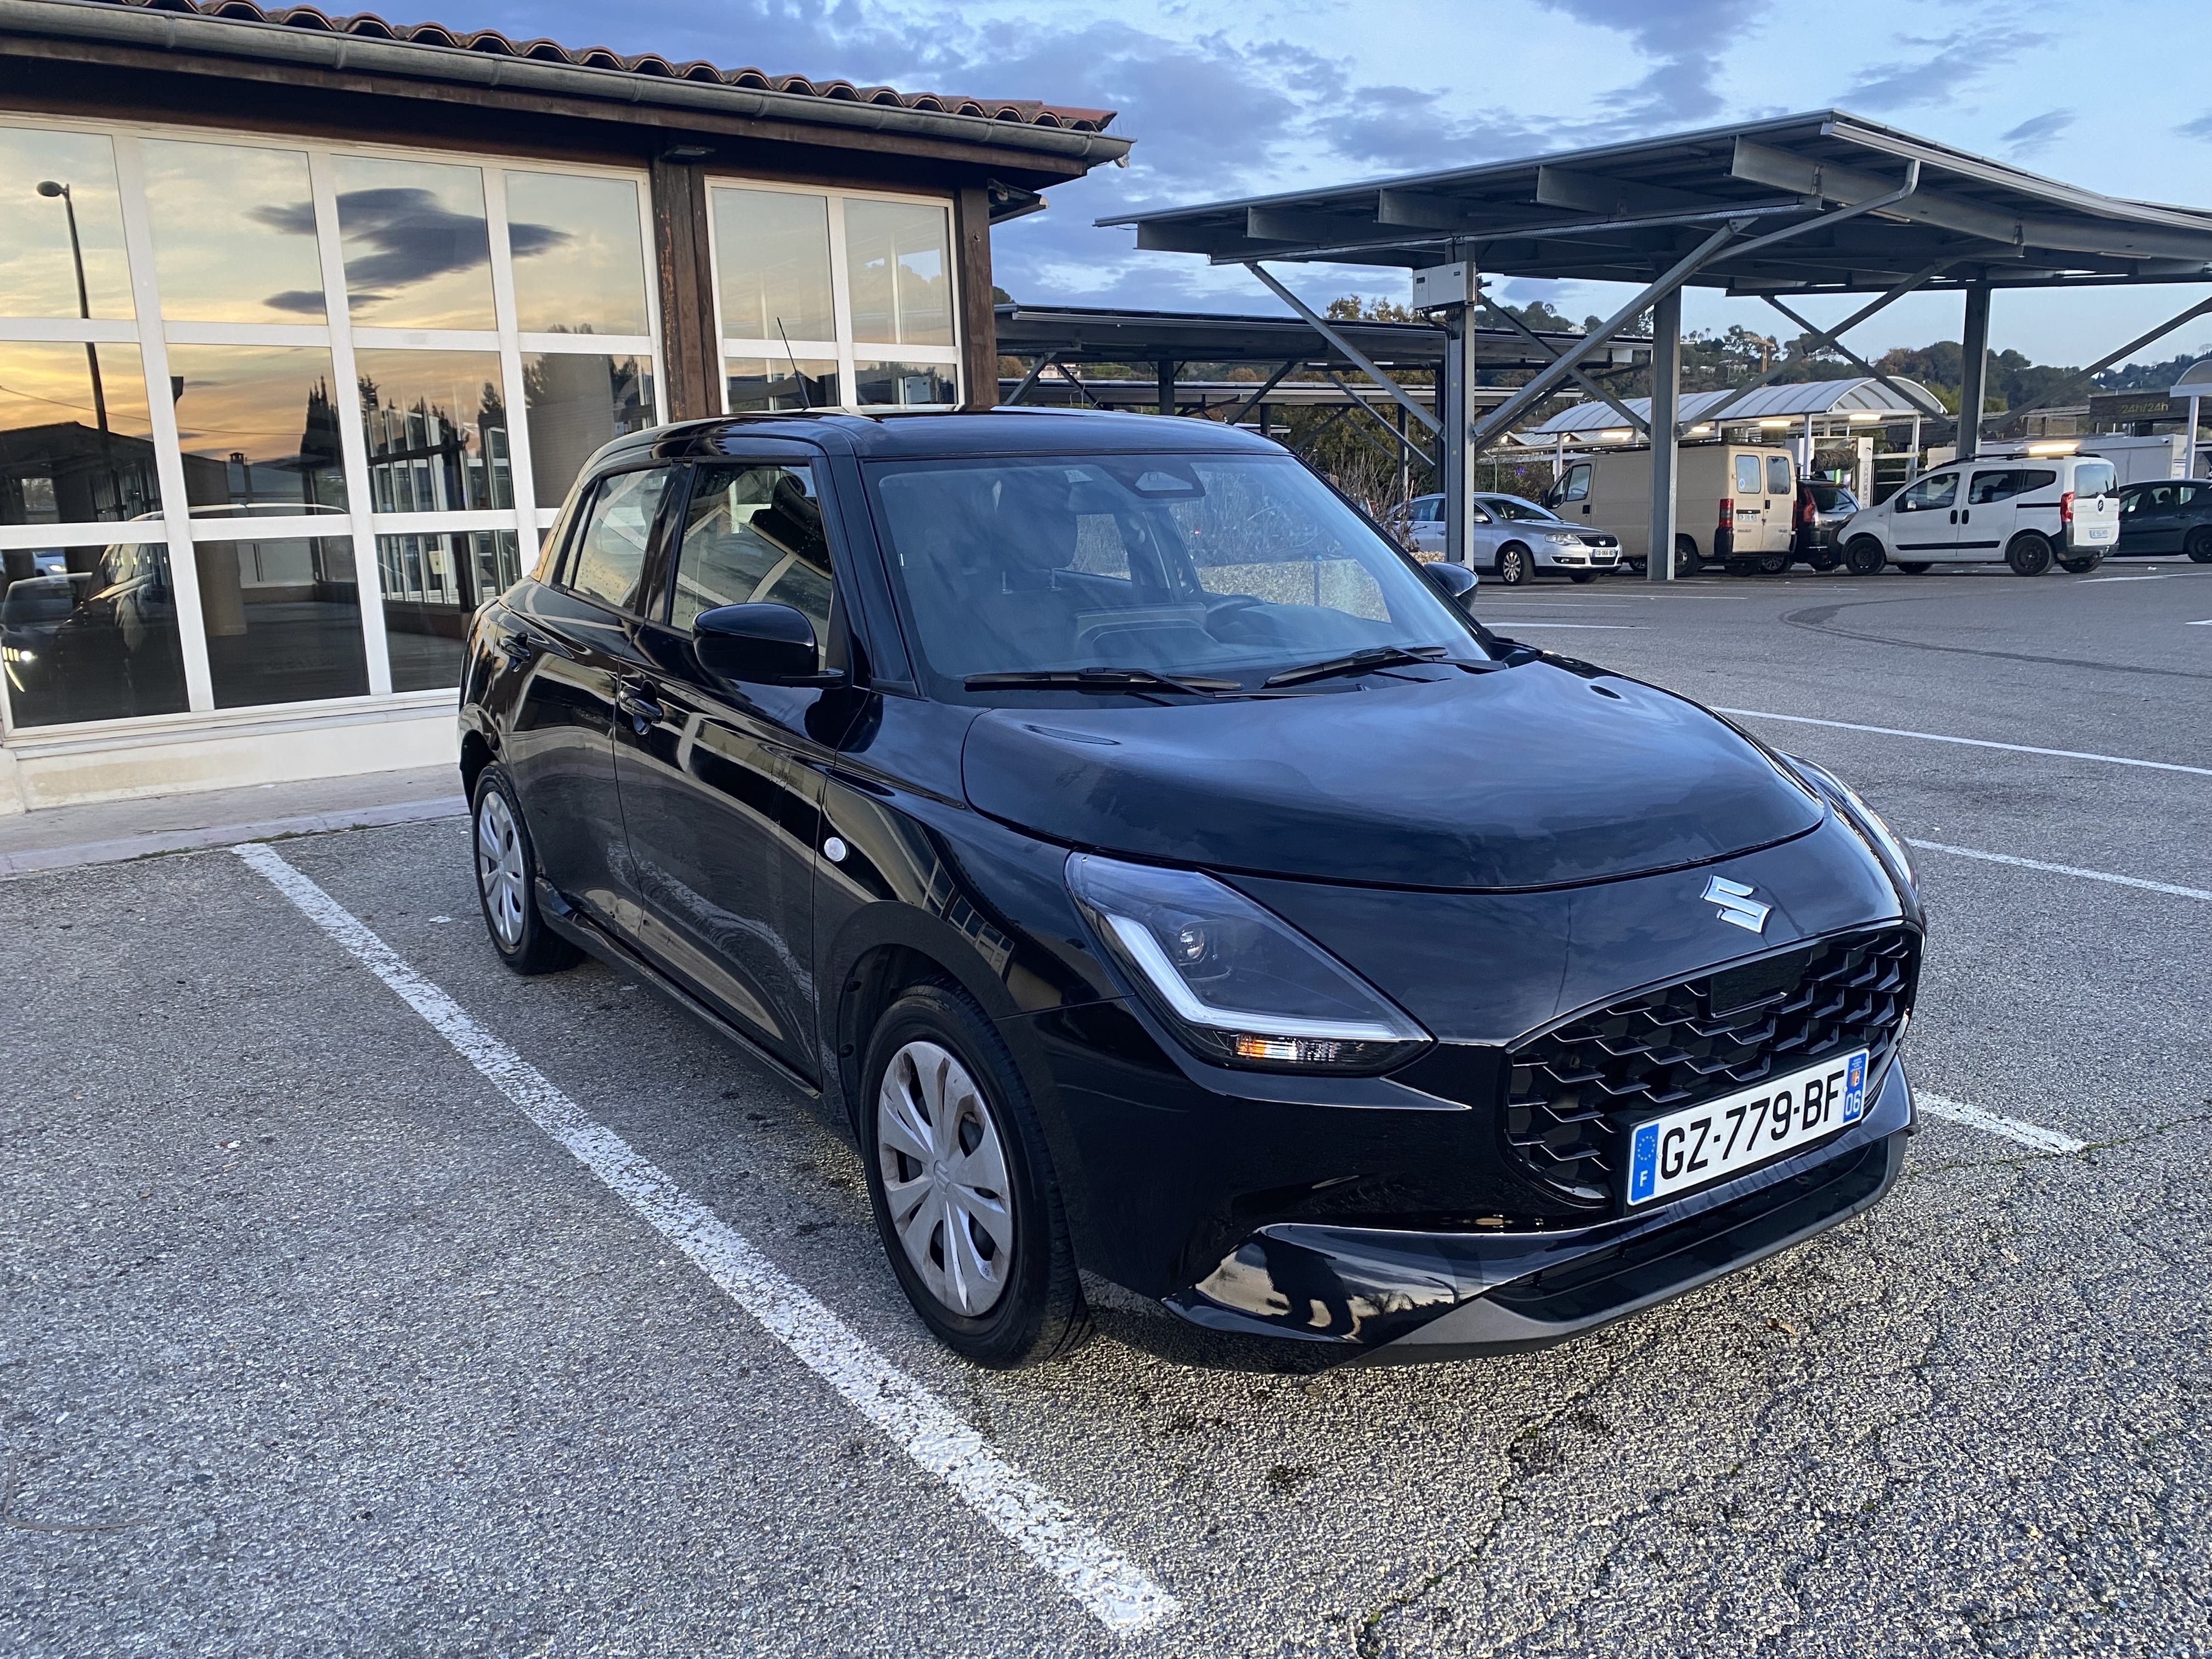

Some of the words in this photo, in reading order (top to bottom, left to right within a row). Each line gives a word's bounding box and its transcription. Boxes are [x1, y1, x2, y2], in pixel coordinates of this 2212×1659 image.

[1845, 1090, 1861, 1116] 06
[1661, 1069, 1845, 1180] GZ-779-BF
[1639, 1170, 1649, 1187] F
